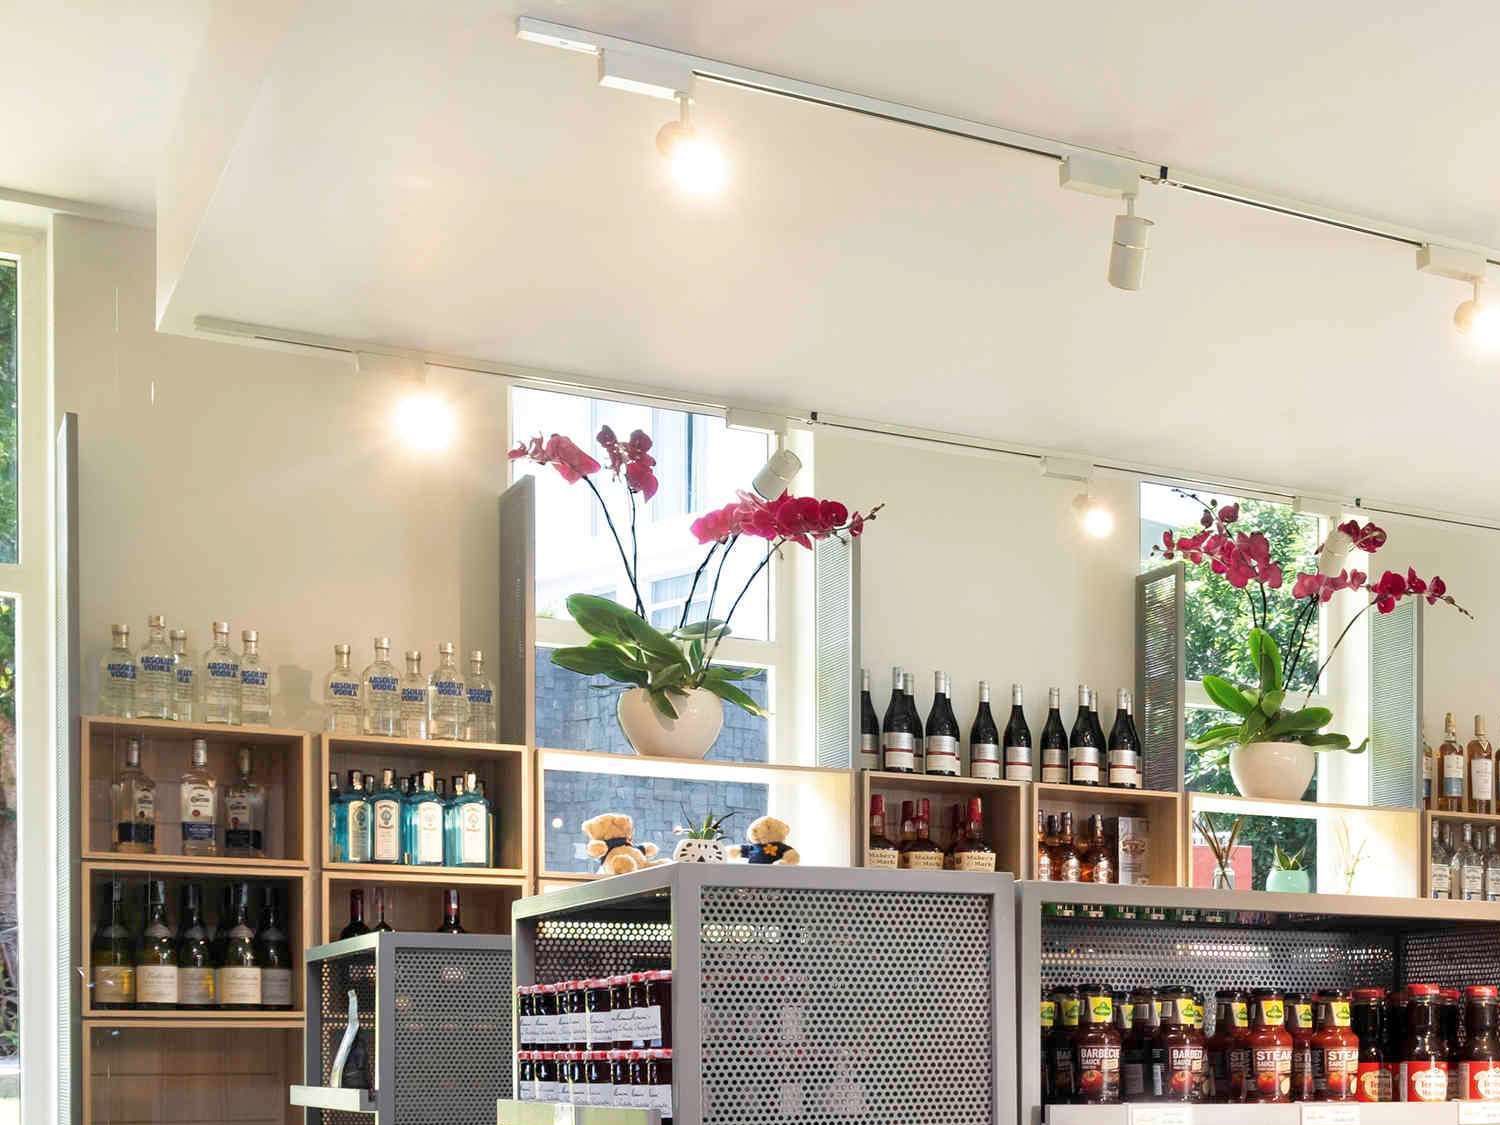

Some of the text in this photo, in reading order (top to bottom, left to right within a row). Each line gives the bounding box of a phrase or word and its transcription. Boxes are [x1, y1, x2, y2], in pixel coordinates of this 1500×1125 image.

[208, 662, 239, 672] ABSOLUT
[210, 669, 236, 678] VODKA
[369, 675, 399, 685] ABSOLUT
[329, 681, 360, 691] ABSOLUT
[371, 682, 396, 692] VODKA
[333, 688, 357, 697] VODKA
